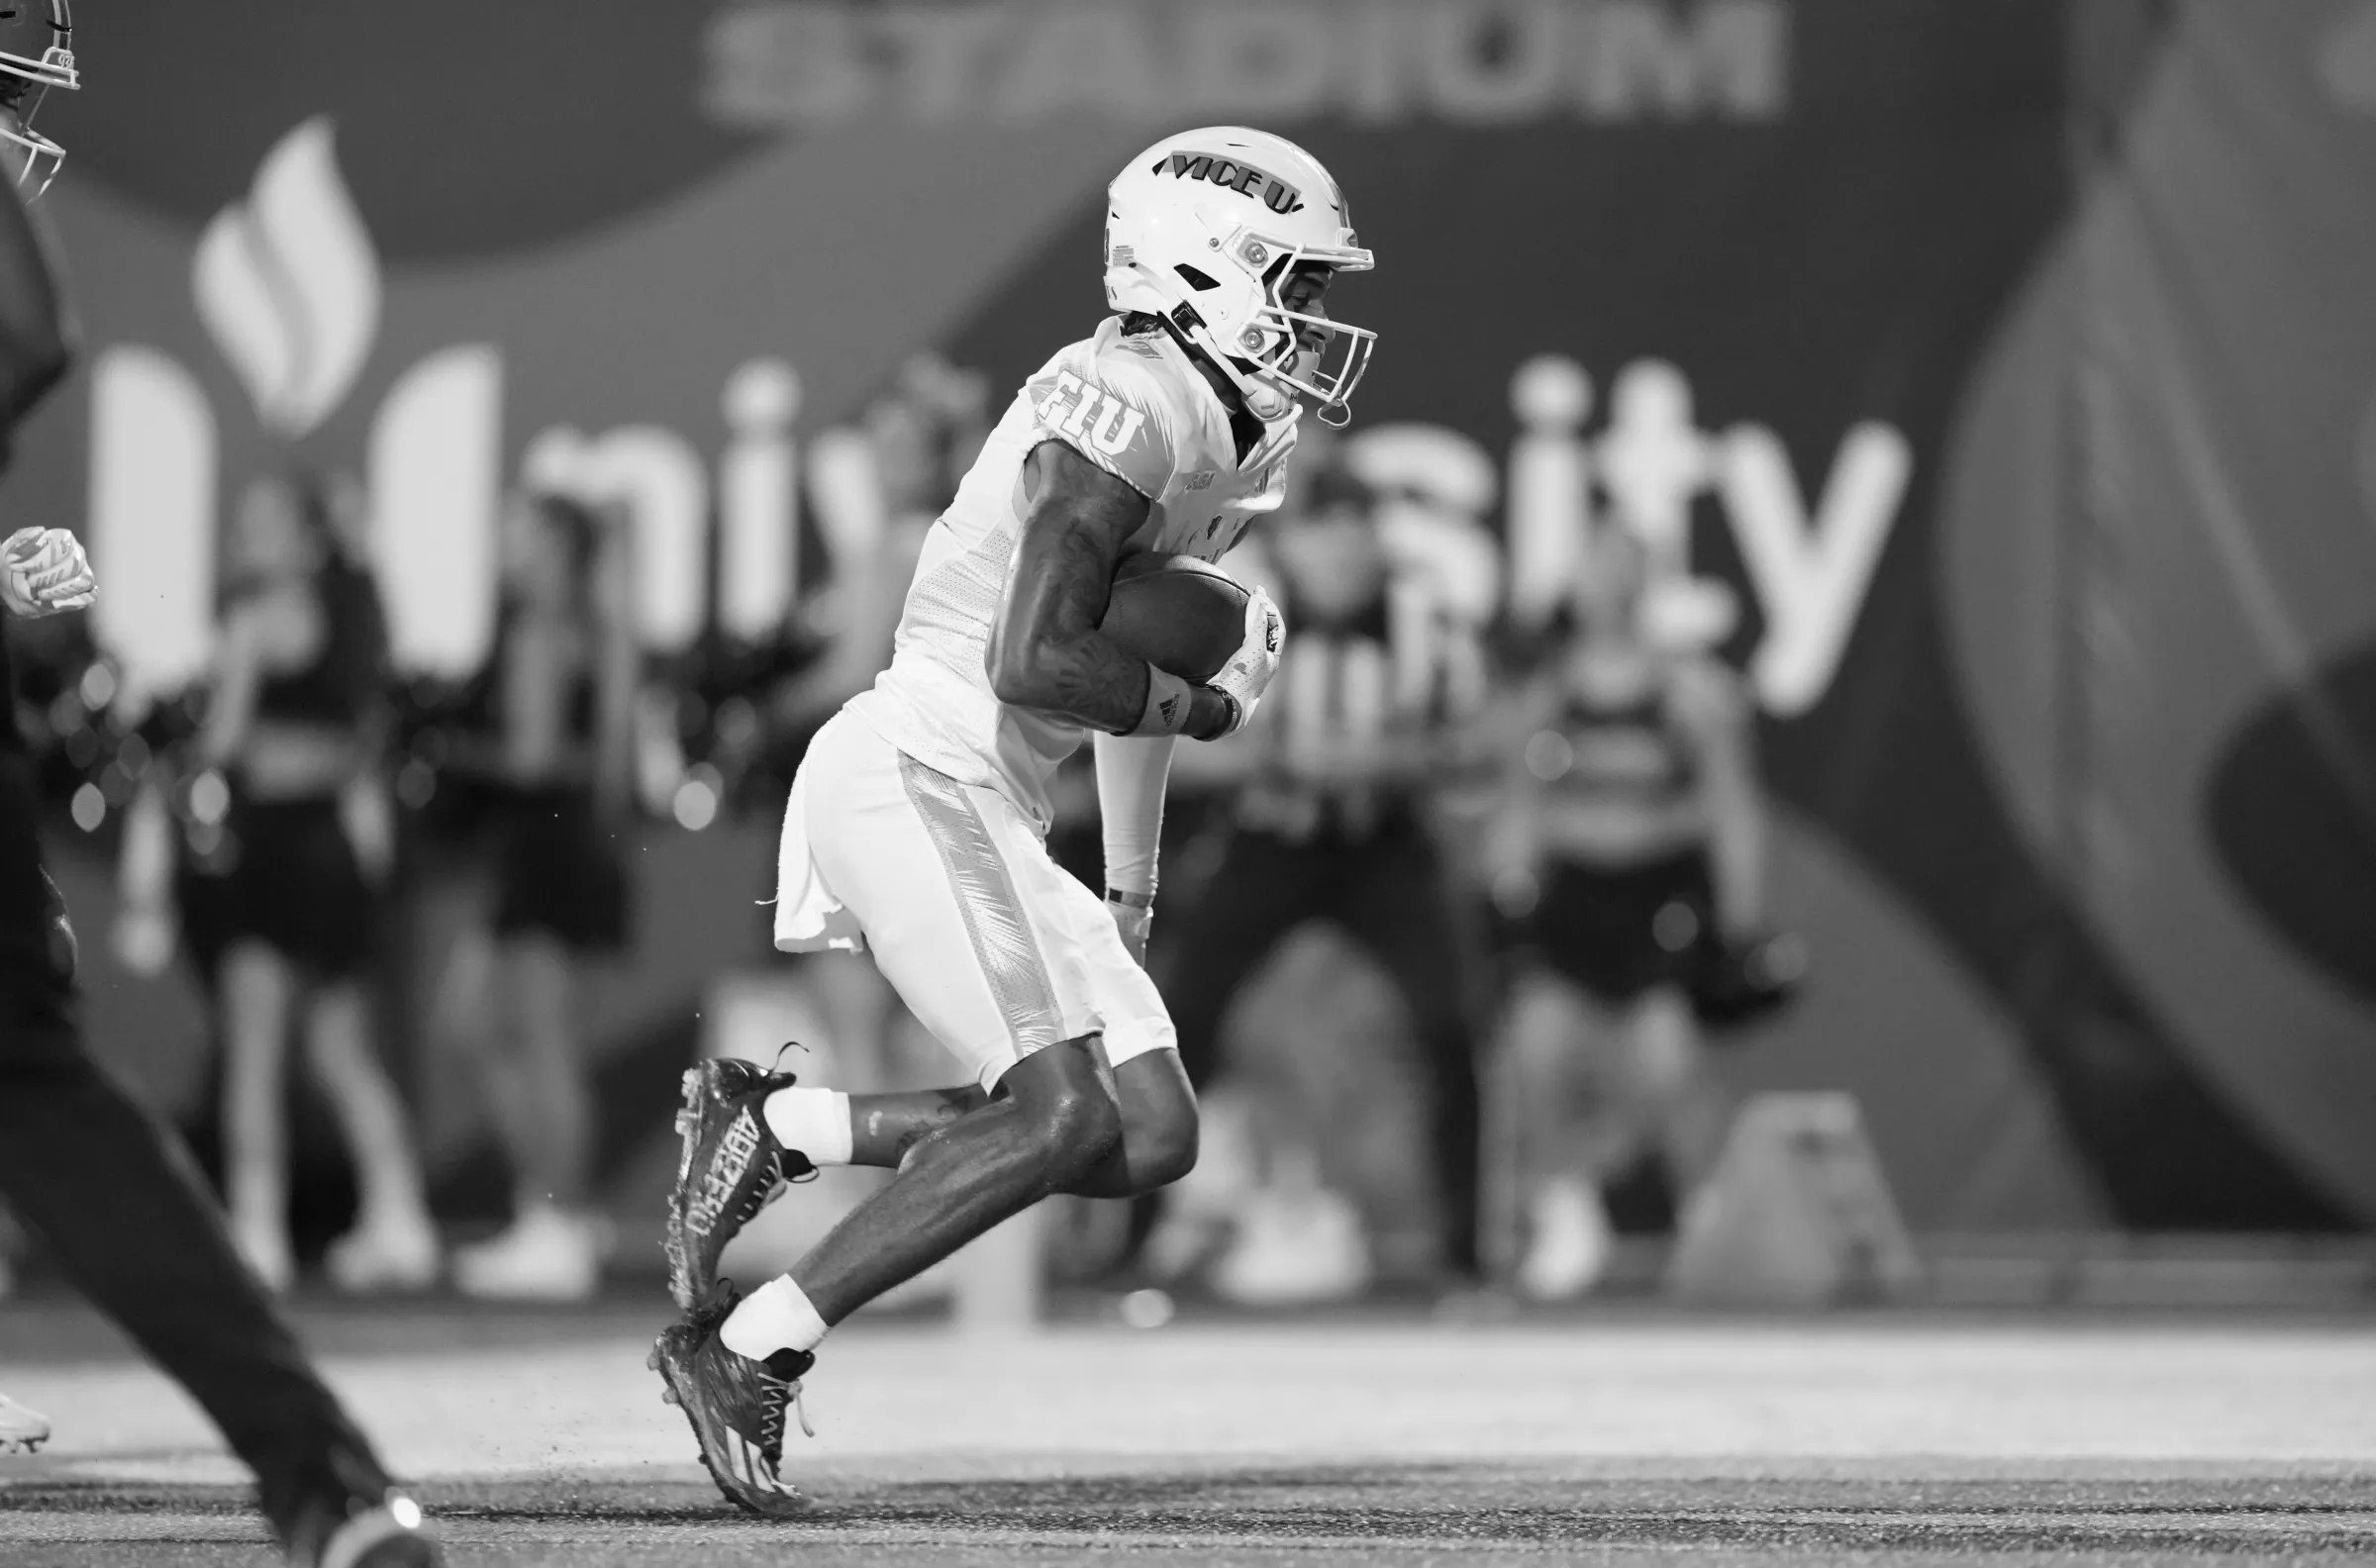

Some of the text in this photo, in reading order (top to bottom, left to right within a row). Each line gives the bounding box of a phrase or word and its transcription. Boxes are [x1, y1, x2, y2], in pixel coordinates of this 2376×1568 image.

[701, 0, 1786, 123] STADIUM
[1171, 153, 1298, 215] VICE U
[1037, 369, 1145, 456] FIU
